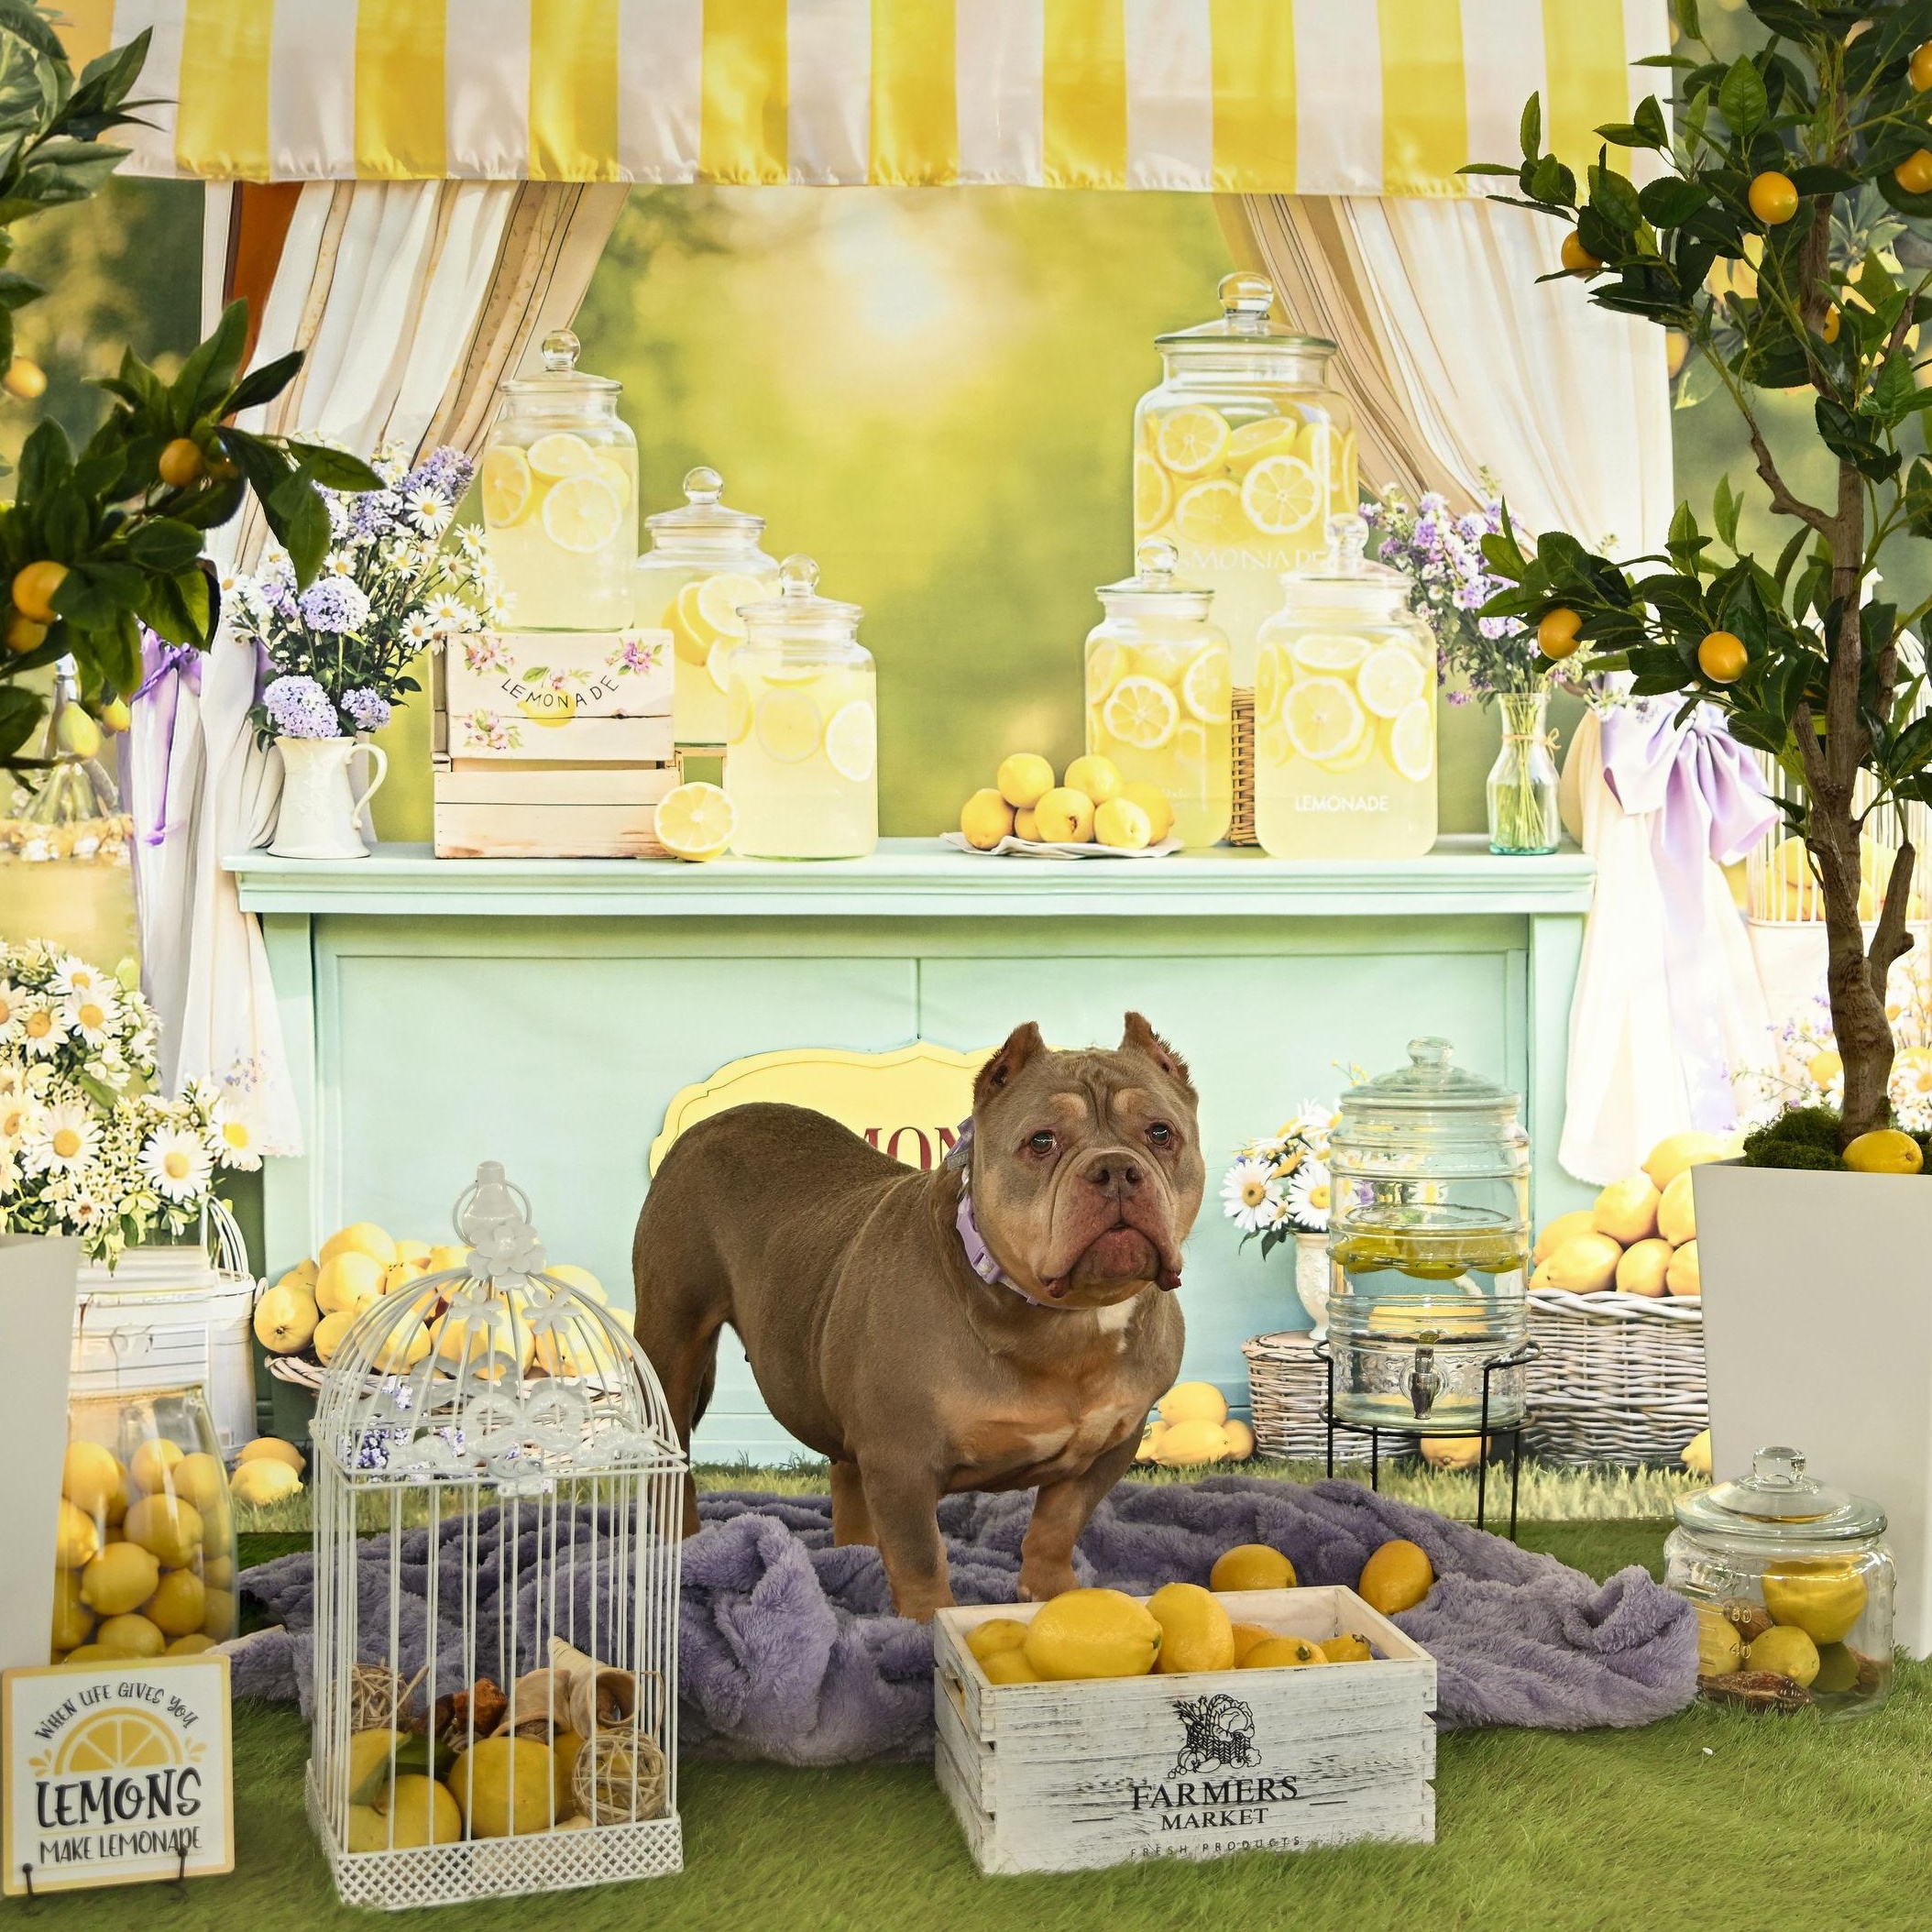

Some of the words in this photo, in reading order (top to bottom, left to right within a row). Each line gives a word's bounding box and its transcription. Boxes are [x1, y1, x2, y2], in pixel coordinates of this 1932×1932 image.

[501, 675, 620, 708] LEMONADE
[1295, 794, 1389, 812] LEMONADE
[35, 1699, 77, 1740] WHEN
[79, 1685, 112, 1707] LIFE
[117, 1682, 165, 1705] GIVES
[167, 1695, 199, 1729] YOU
[35, 1766, 203, 1828] LEMONS
[1132, 1775, 1298, 1810] FARMERS
[1160, 1807, 1269, 1831] MARKET
[39, 1836, 93, 1864] MAKE
[99, 1826, 203, 1859] LEMONADE
[1130, 1843, 1188, 1858] FRESH
[1202, 1836, 1300, 1853] PRODUCTS
